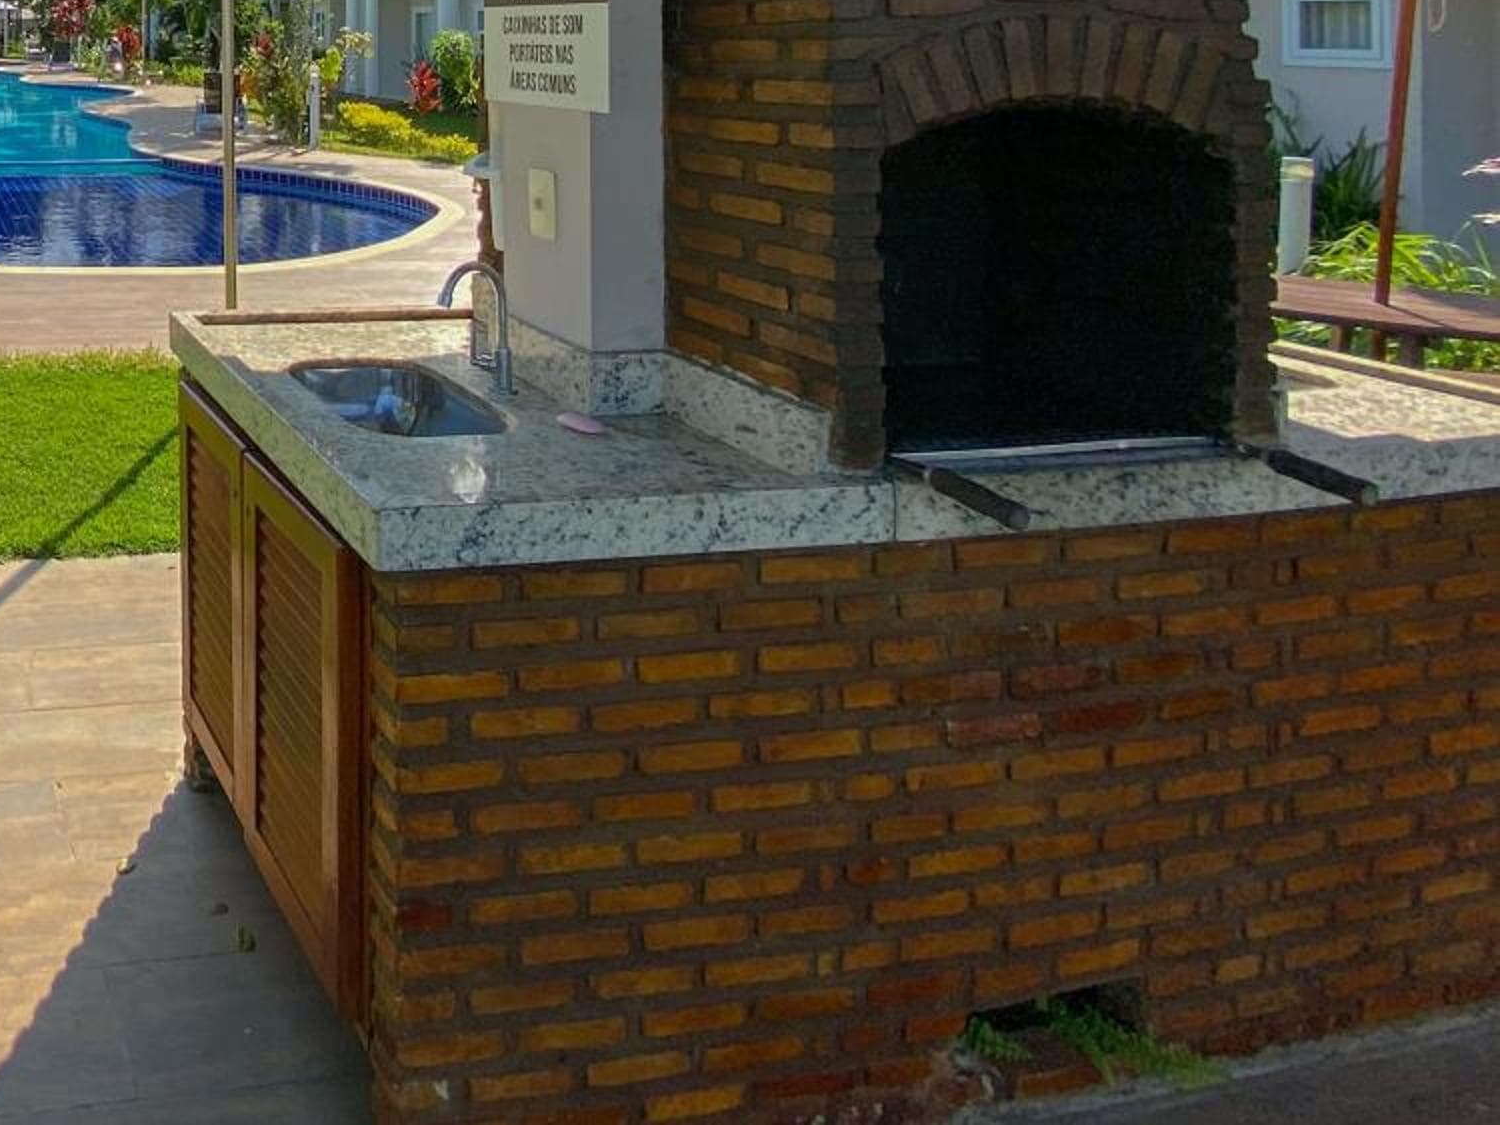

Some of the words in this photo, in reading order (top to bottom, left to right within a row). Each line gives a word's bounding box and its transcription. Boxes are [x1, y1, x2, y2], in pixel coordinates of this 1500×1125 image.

[503, 14, 547, 35] CAIXINHAS
[549, 14, 561, 35] DE
[563, 14, 584, 35] SOM
[555, 44, 575, 65] NAS
[537, 72, 578, 95] COMUNS
